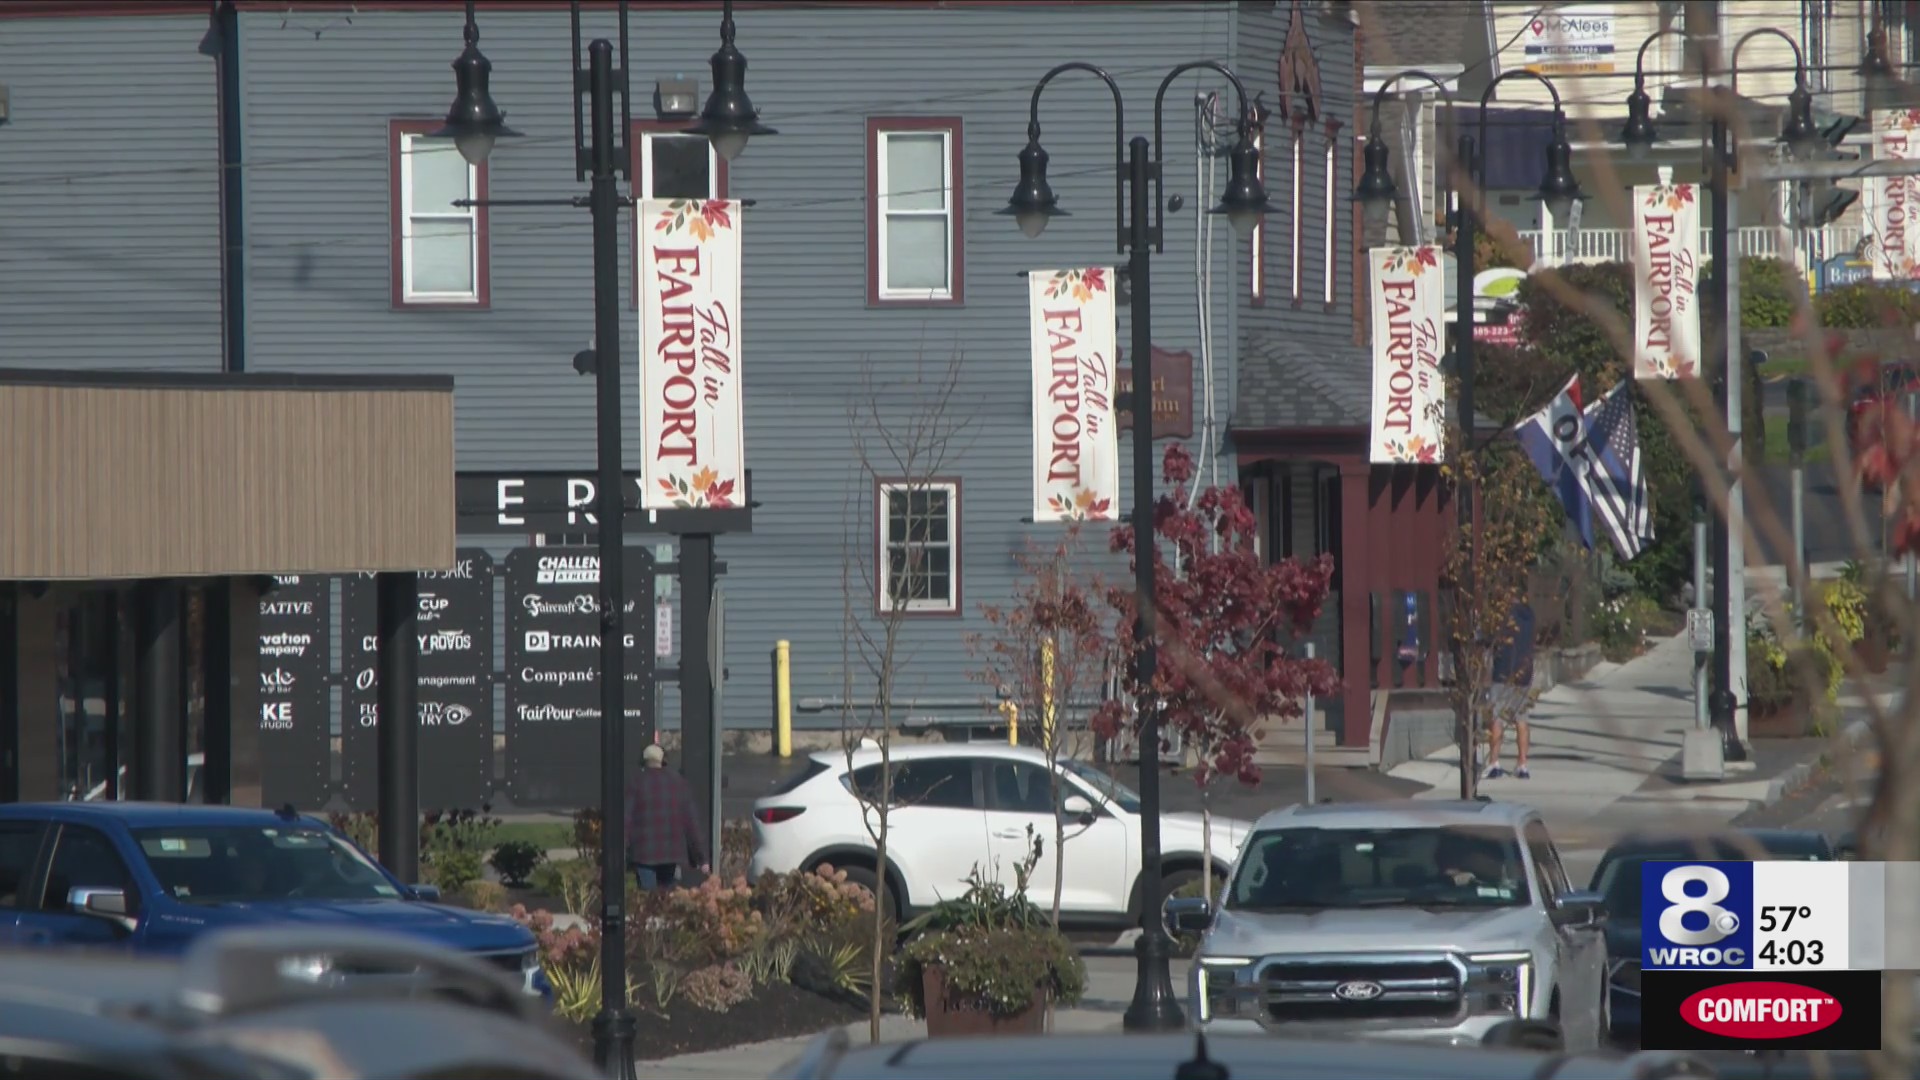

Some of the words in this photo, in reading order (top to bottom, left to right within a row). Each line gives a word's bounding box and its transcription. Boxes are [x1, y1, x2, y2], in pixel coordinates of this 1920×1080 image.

[1882, 134, 1908, 256] FRPORT
[1644, 214, 1675, 352] FAIRPORT
[1672, 248, 1694, 296] Fall
[1676, 296, 1689, 316] in
[696, 300, 732, 375] Fall
[1413, 317, 1438, 369] Fall
[653, 245, 701, 466] FAIRPORT
[1382, 279, 1416, 434] FAIRPORT
[703, 378, 725, 408] in
[1079, 352, 1109, 411] Fall
[1418, 371, 1433, 396] in
[1043, 307, 1083, 488] FAIRPORT
[1086, 414, 1103, 441] in
[538, 556, 600, 569] CHALLEN
[419, 599, 449, 610] CUP
[260, 632, 311, 645] vation
[260, 646, 305, 658] ompany
[551, 634, 635, 648] TRAING
[418, 675, 476, 688] anagement
[521, 666, 594, 687] Compané
[262, 702, 292, 721] KE
